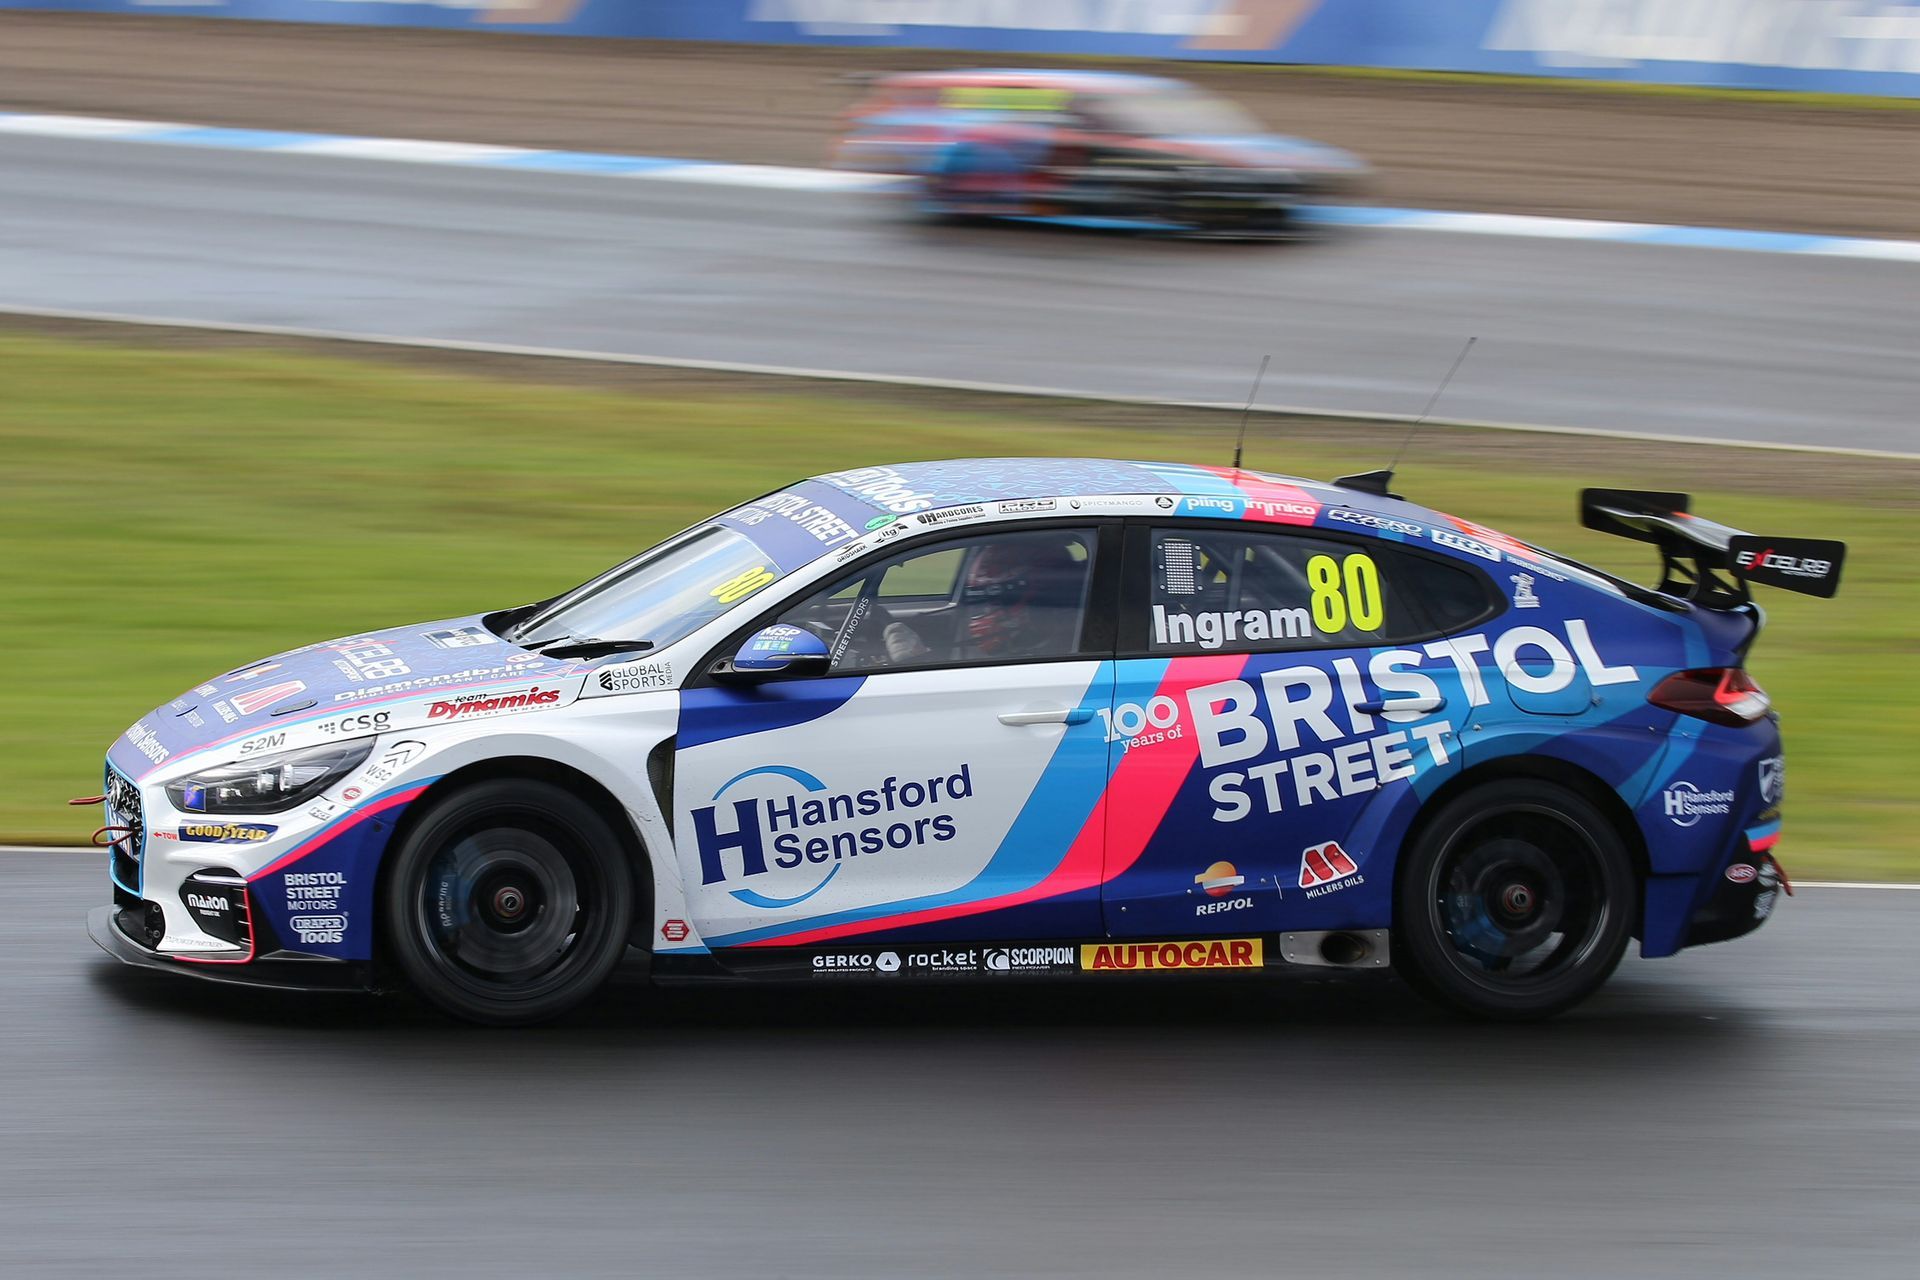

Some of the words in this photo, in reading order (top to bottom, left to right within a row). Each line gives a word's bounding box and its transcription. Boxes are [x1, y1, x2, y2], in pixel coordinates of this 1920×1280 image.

[924, 506, 984, 522] HARDCORES
[1187, 497, 1234, 512] pling
[791, 506, 860, 546] STREET
[1736, 548, 1832, 575] EXCELR8
[709, 566, 775, 604] 80
[1306, 553, 1384, 634] 80
[761, 627, 801, 636] MSP
[831, 633, 851, 667] STREET
[847, 597, 869, 634] MOTORS
[1152, 604, 1313, 649] Ingram
[612, 663, 665, 678] GLOBAL
[665, 661, 673, 685] MEDIA
[613, 675, 666, 691] SPORTS
[427, 687, 561, 720] Dynamics
[454, 693, 487, 704] team
[1185, 619, 1640, 769] BRISTOL
[340, 711, 391, 732] csg
[1096, 695, 1179, 743] 100
[240, 733, 286, 754] S2M
[1120, 732, 1165, 754] years
[1167, 724, 1183, 740] of
[366, 764, 393, 781] WSC
[1208, 720, 1452, 823] STREET
[766, 764, 973, 832] Hansford
[162, 832, 178, 841] TOW
[186, 823, 269, 841] GOODYEAR
[774, 813, 957, 869] Sensors
[284, 872, 347, 886] BRISTOL
[1306, 882, 1344, 900] MILLERS
[1345, 874, 1365, 888] OILS
[286, 886, 341, 899] STREET
[287, 900, 337, 910] MOTORS
[1196, 898, 1254, 916] REPSOL
[295, 918, 342, 929] DRAPER
[300, 930, 343, 943] Tools
[812, 955, 873, 967] GERKO
[908, 950, 977, 967] rocket
[1011, 947, 1074, 966] SCORPION
[1092, 940, 1253, 969] AUTOCAR
